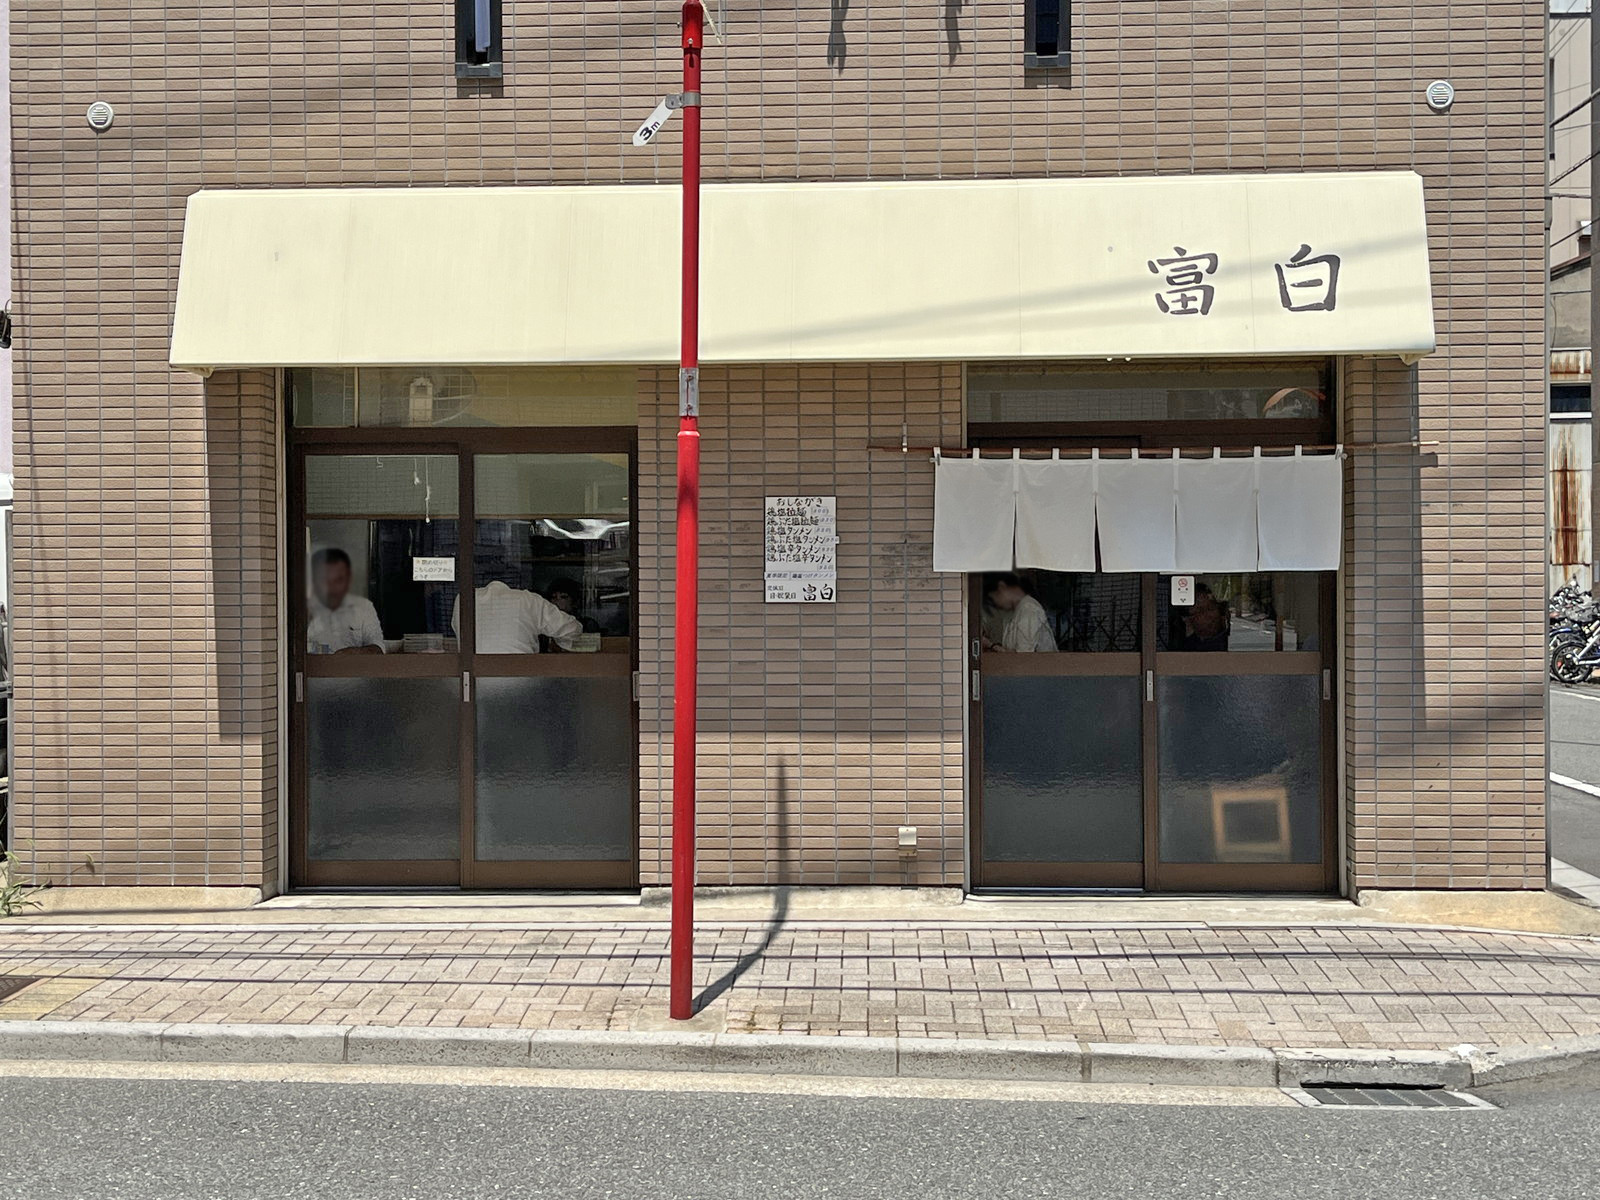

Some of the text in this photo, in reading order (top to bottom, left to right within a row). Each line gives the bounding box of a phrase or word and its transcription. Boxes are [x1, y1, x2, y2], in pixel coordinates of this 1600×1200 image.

[639, 121, 661, 141] 3m
[1147, 243, 1341, 316] 富白
[777, 497, 823, 507] おしながき
